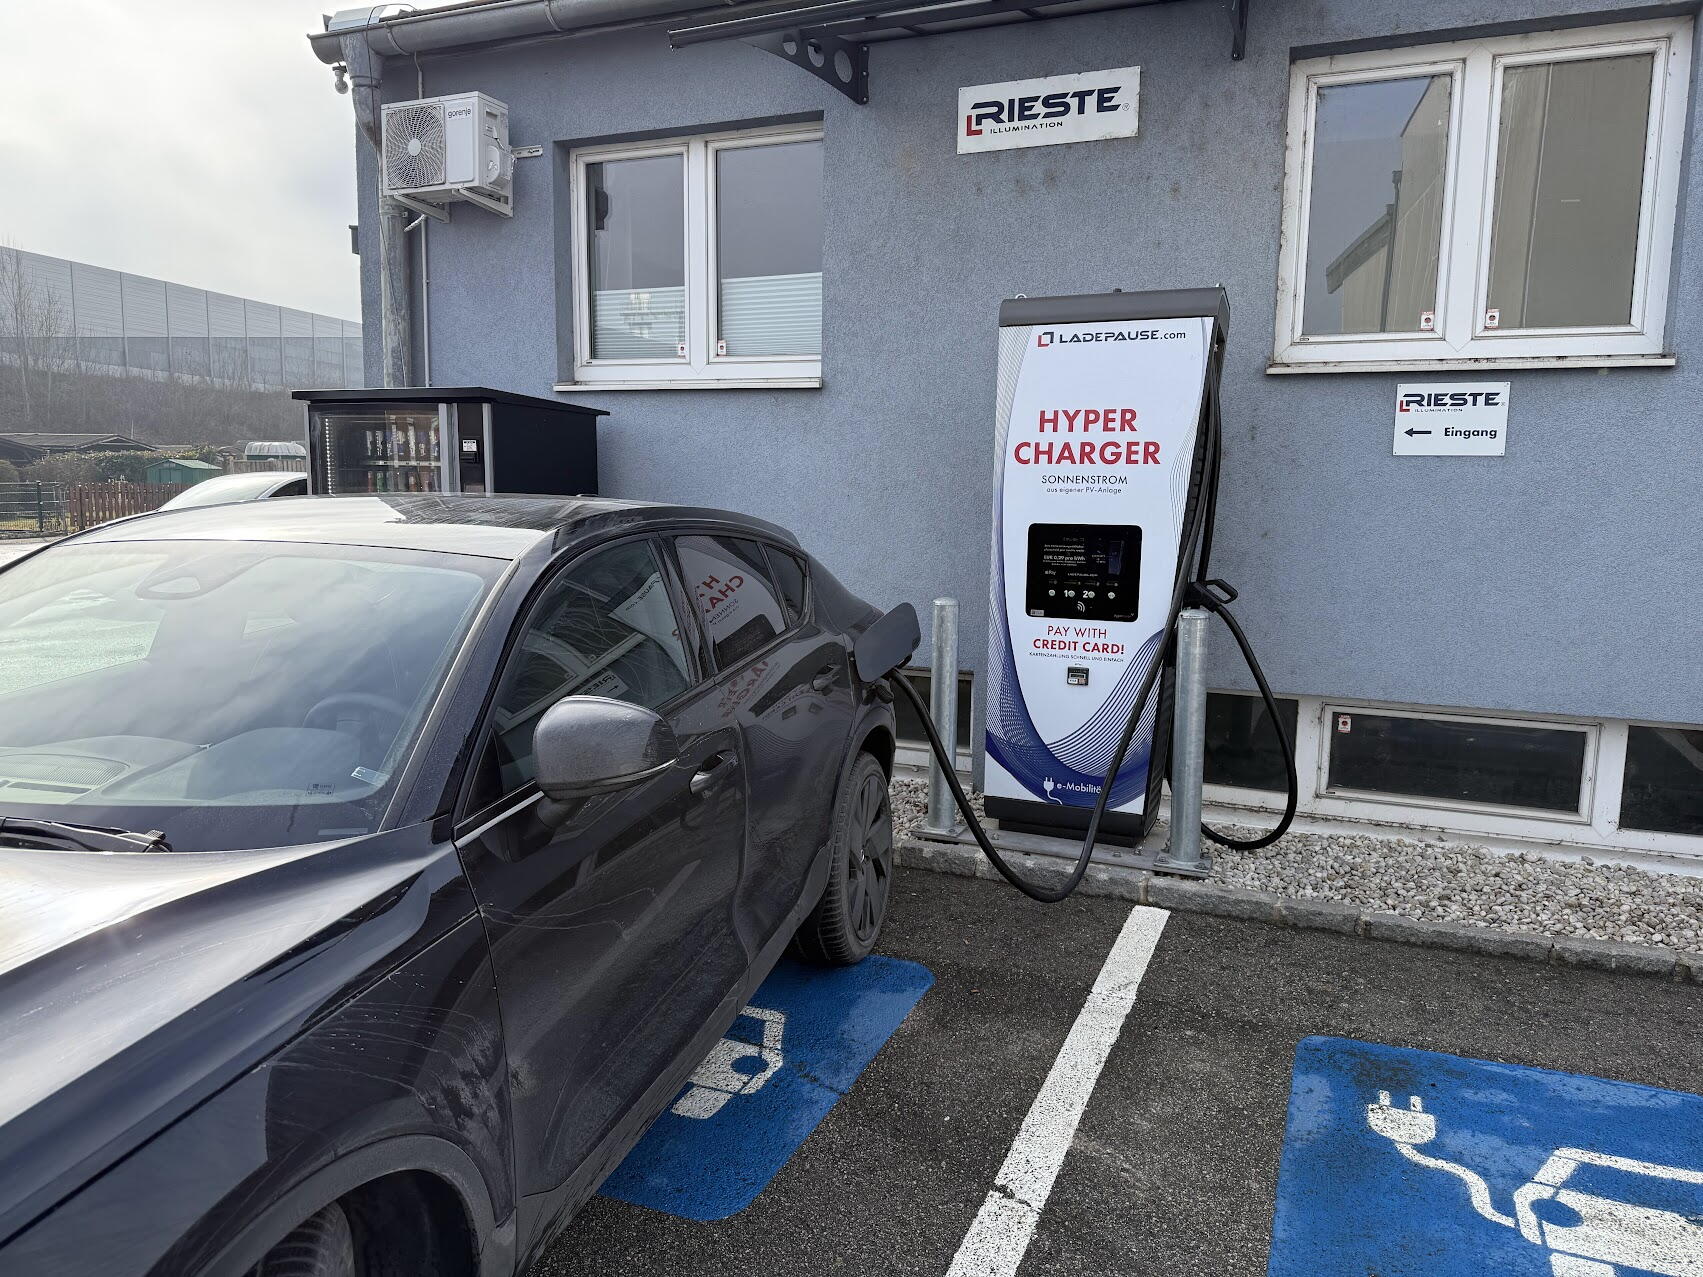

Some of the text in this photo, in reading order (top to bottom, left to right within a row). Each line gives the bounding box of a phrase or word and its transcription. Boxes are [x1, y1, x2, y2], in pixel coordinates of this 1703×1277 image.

[447, 107, 472, 119] gorenje
[989, 121, 1064, 134] ILLUMINATION
[1059, 330, 1187, 344] LADEPAUSE.com
[1038, 408, 1138, 433] HYPER
[1444, 426, 1498, 440] Eingang
[1013, 441, 1162, 465] CHARGER
[1041, 475, 1128, 485] SONNENSTROM
[1059, 487, 1084, 495] eigener
[1085, 486, 1122, 495] PV-Anlage
[1047, 625, 1107, 639] PAY WITH
[1033, 638, 1125, 655] CREDIT CARD!
[1056, 782, 1102, 794] e-Mobilitä
